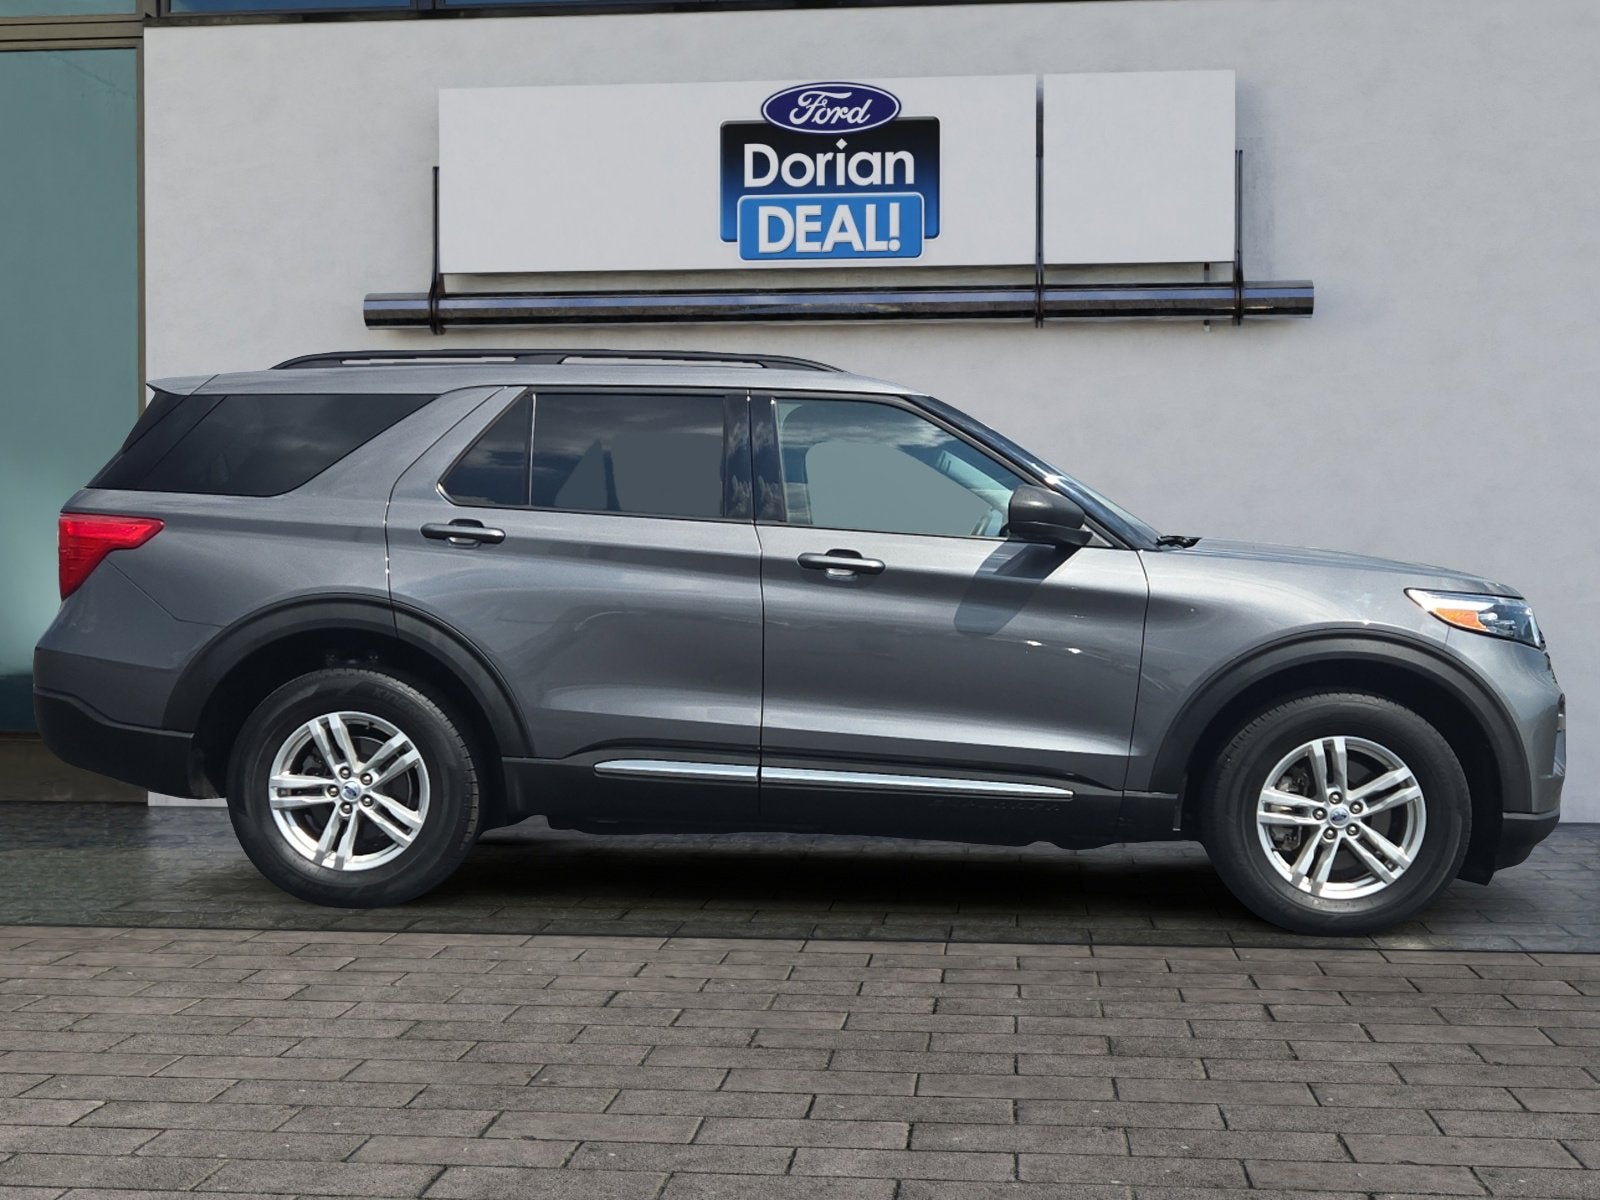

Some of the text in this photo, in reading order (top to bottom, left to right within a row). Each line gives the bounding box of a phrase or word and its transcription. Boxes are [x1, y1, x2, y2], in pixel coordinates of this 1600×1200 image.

[789, 90, 873, 125] Ford
[744, 138, 915, 188] Dorian
[758, 202, 900, 254] DEAL!
